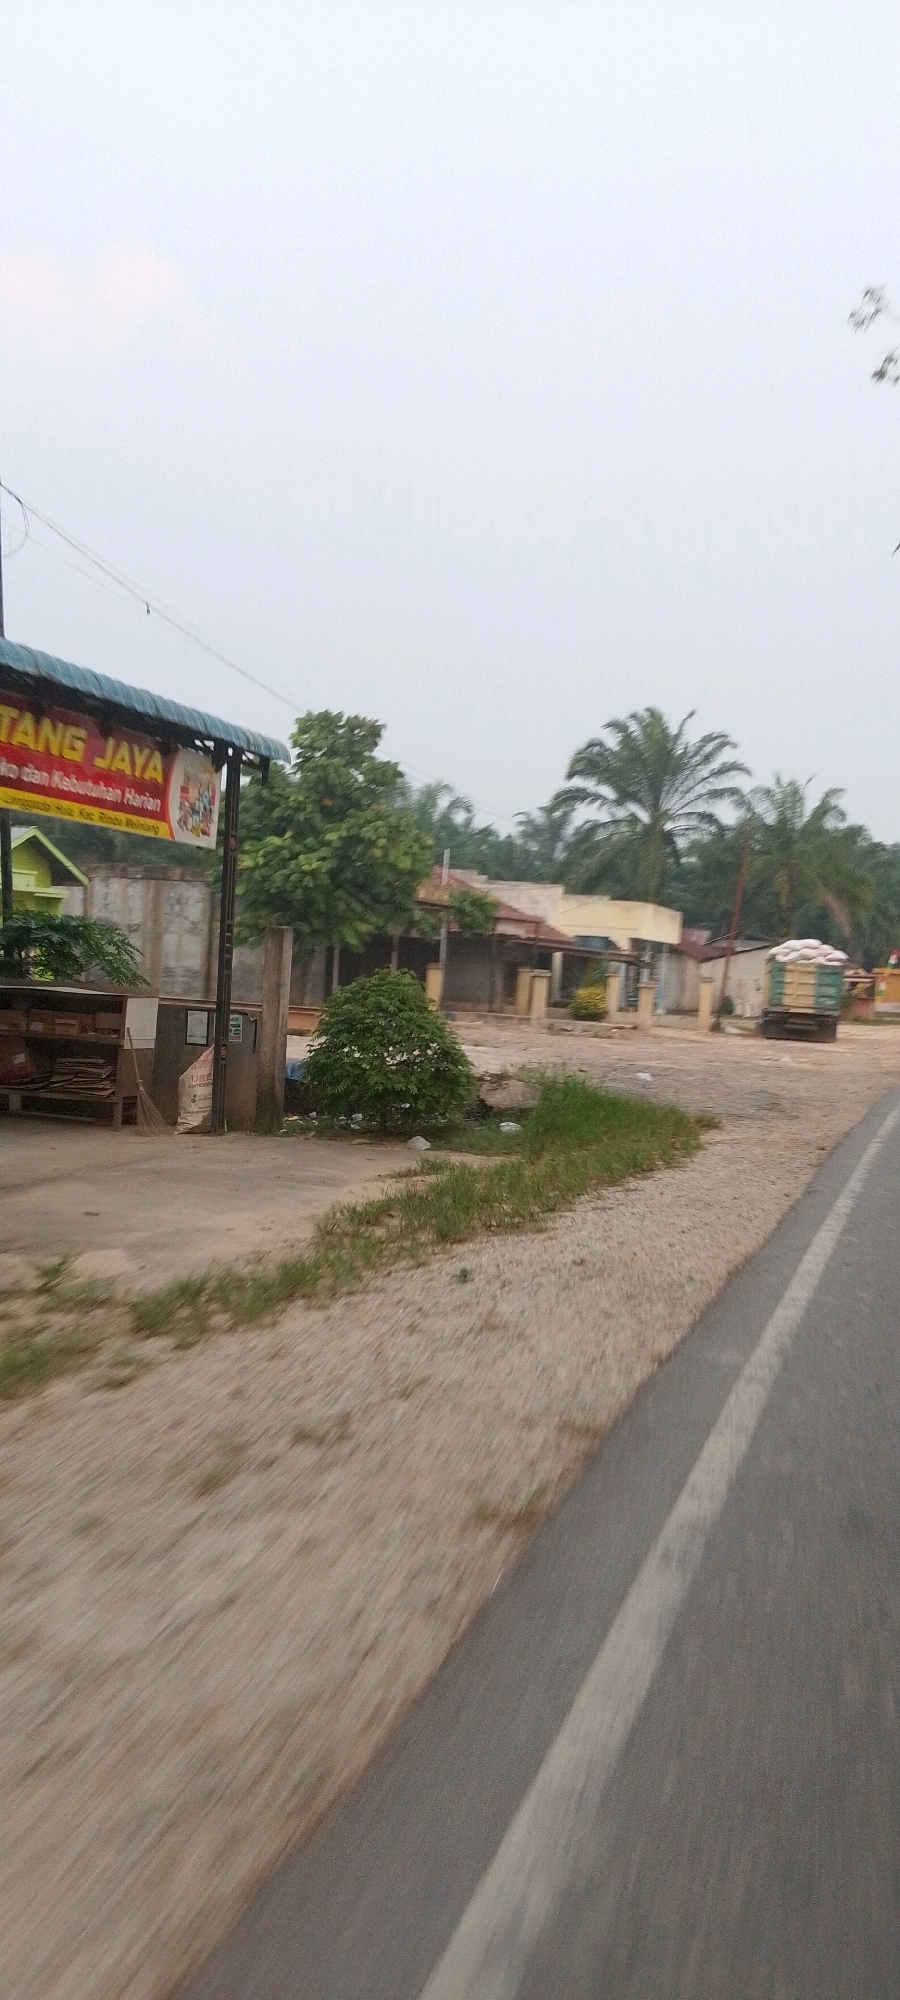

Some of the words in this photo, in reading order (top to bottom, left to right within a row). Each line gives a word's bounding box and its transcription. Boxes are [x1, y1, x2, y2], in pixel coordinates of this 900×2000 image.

[94, 737, 163, 786] JAYA
[20, 762, 50, 786] dan
[50, 769, 122, 803] Kebutuhan
[123, 787, 161, 812] Harian
